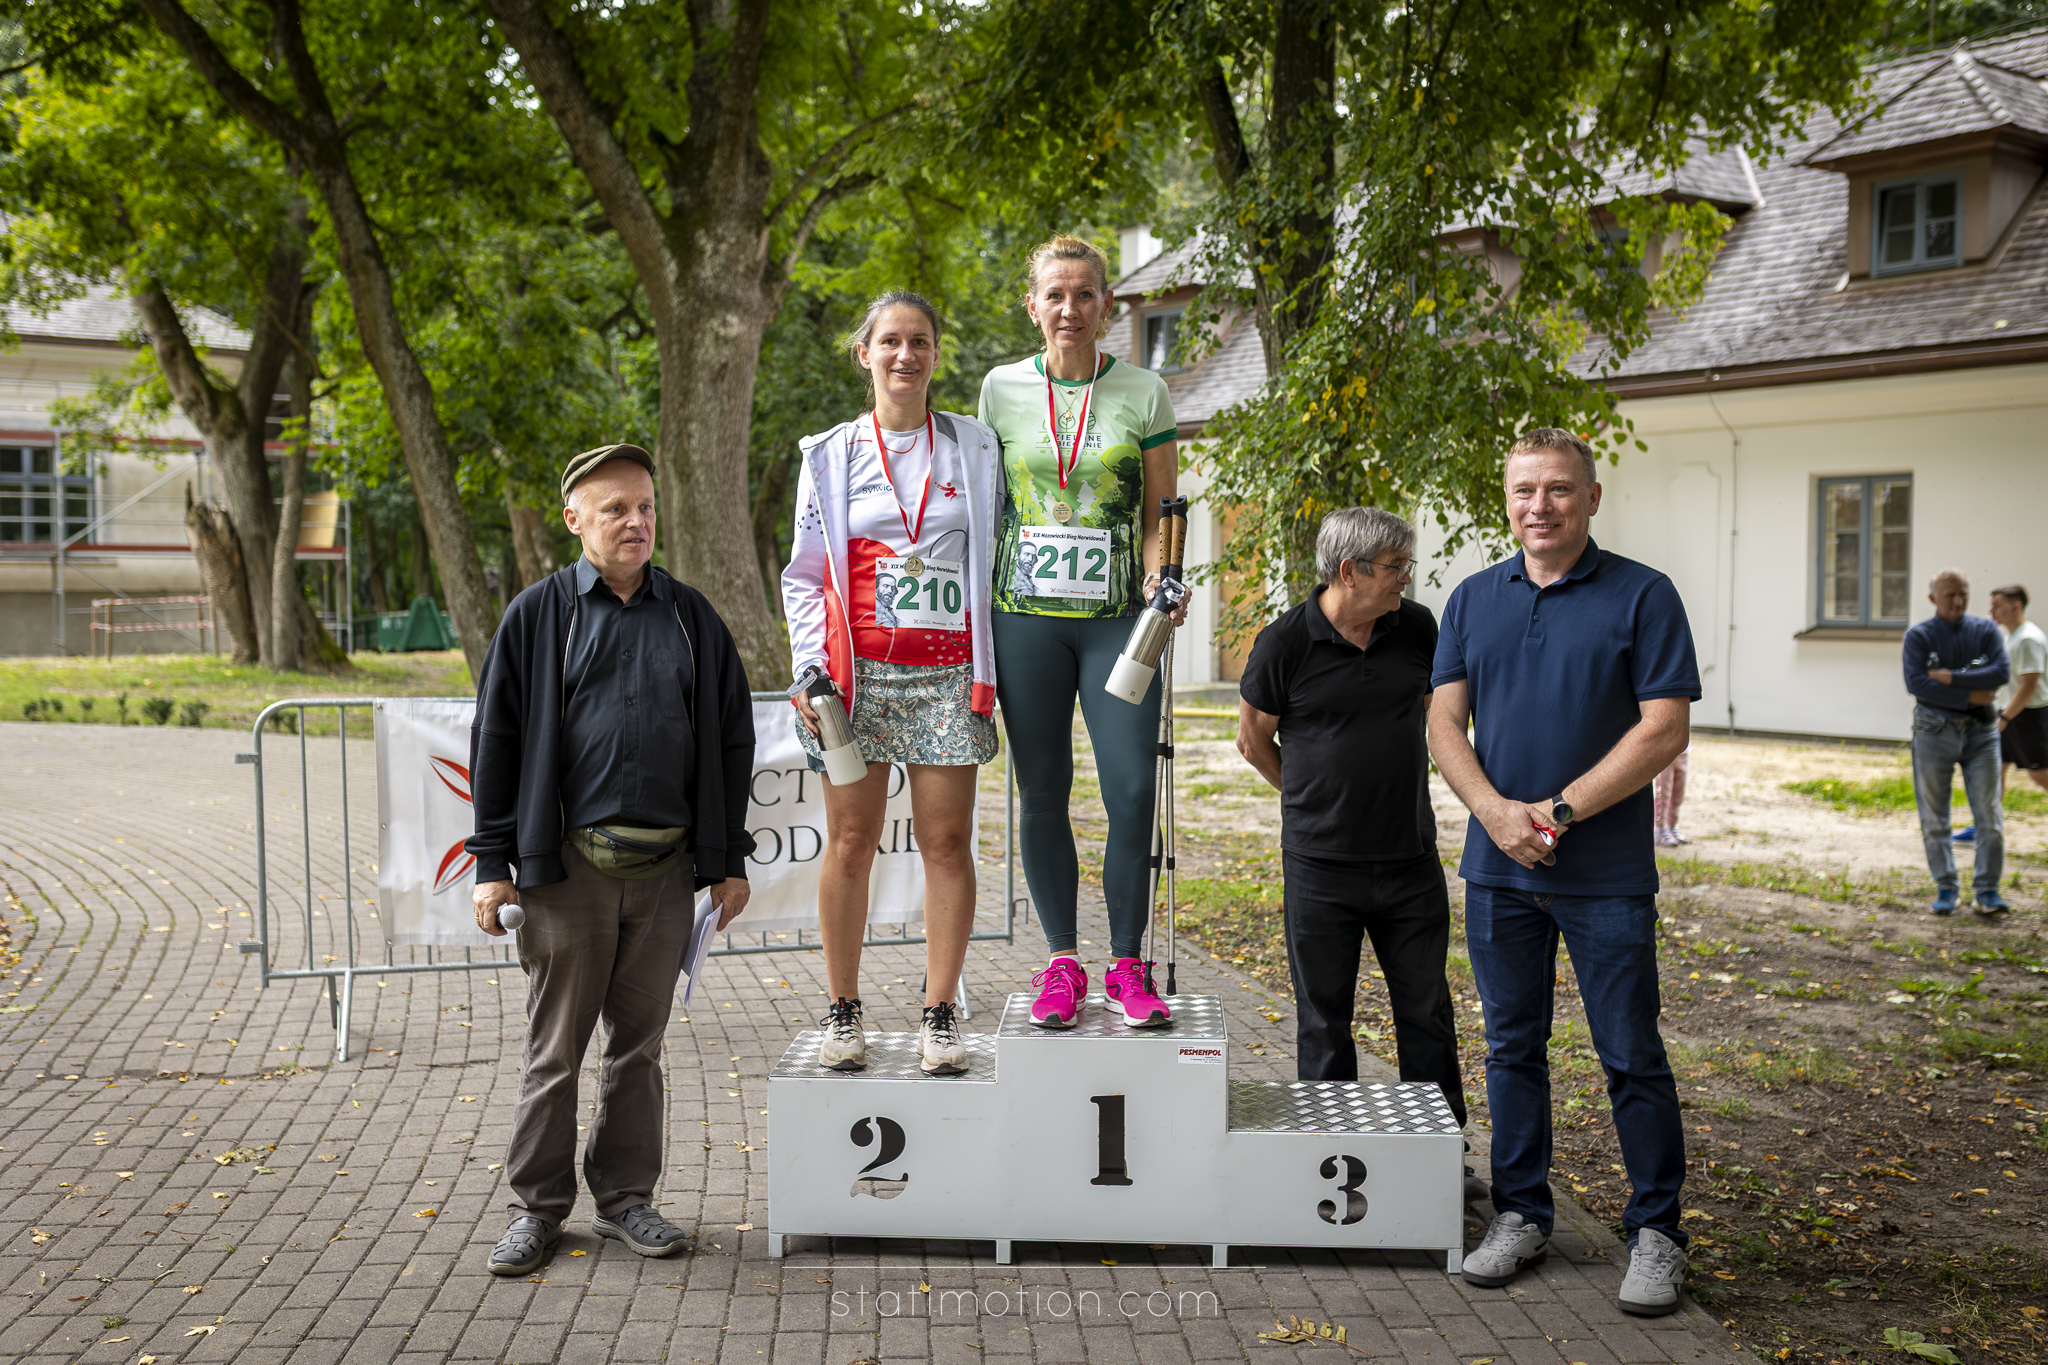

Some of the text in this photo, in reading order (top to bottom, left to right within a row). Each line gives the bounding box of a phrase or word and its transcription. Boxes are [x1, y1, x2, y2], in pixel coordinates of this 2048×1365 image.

[1035, 545, 1107, 582] 212
[896, 576, 962, 614] 210
[1178, 1048, 1222, 1056] PESMENPOL
[850, 1116, 909, 1200] 2
[1090, 1095, 1133, 1186] 1
[1317, 1154, 1368, 1226] 3
